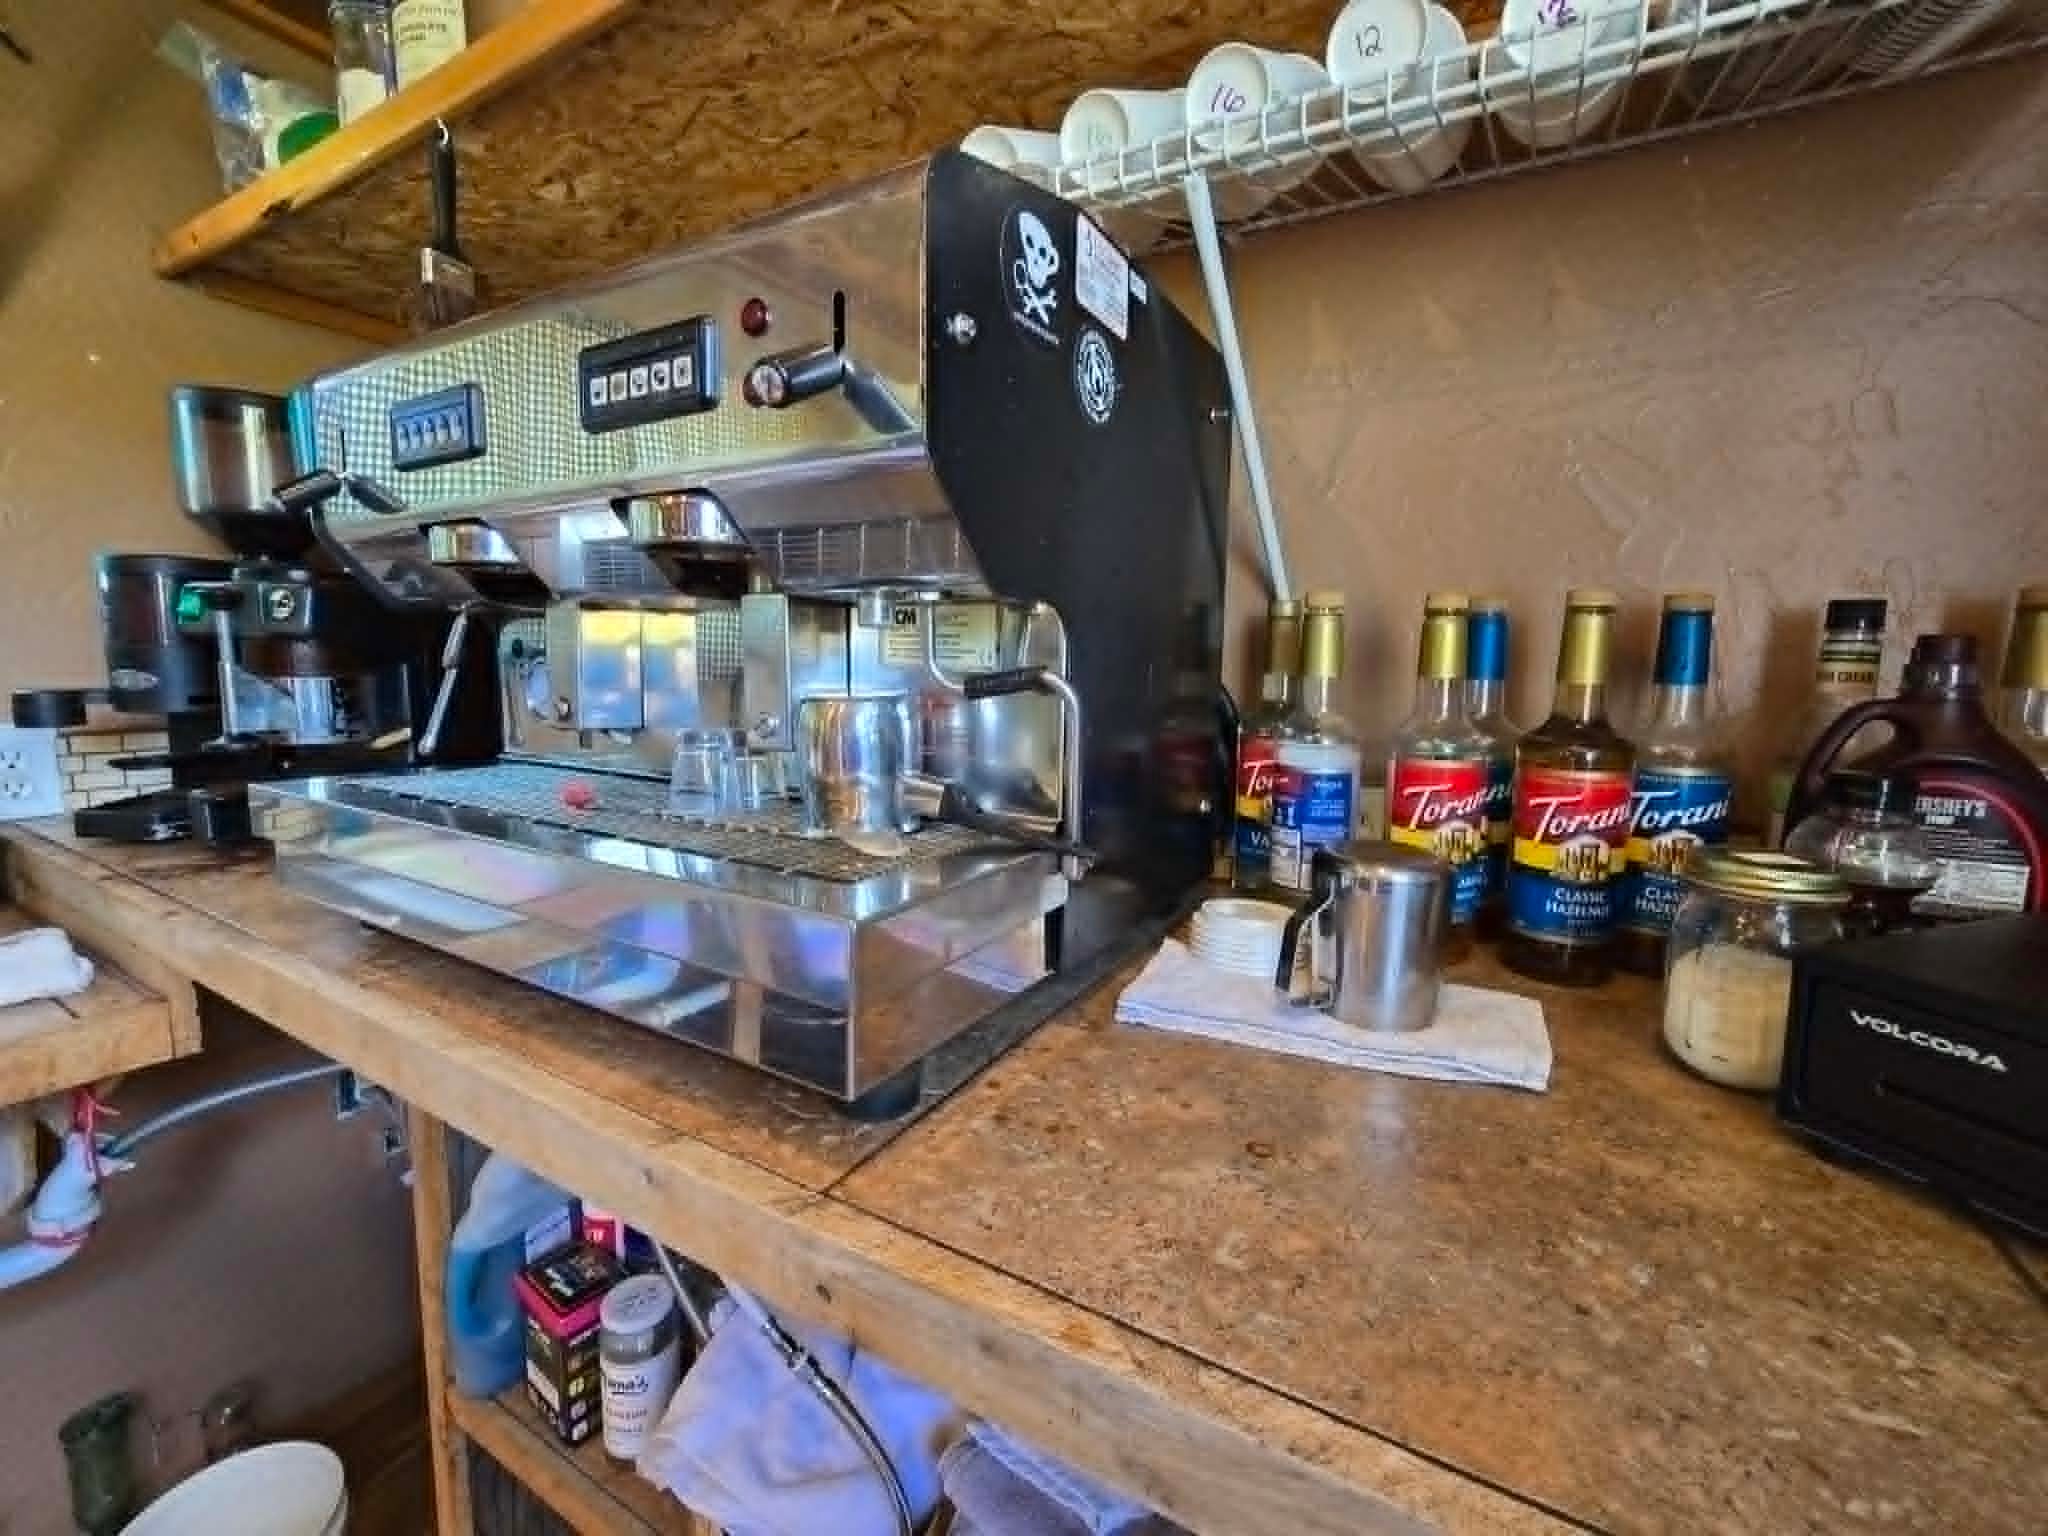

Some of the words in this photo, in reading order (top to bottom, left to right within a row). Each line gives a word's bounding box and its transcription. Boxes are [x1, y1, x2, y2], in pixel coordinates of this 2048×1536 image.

[1355, 25, 1383, 57] 12
[1211, 82, 1247, 113] 16
[1849, 1008, 2009, 1074] VOLCORA
